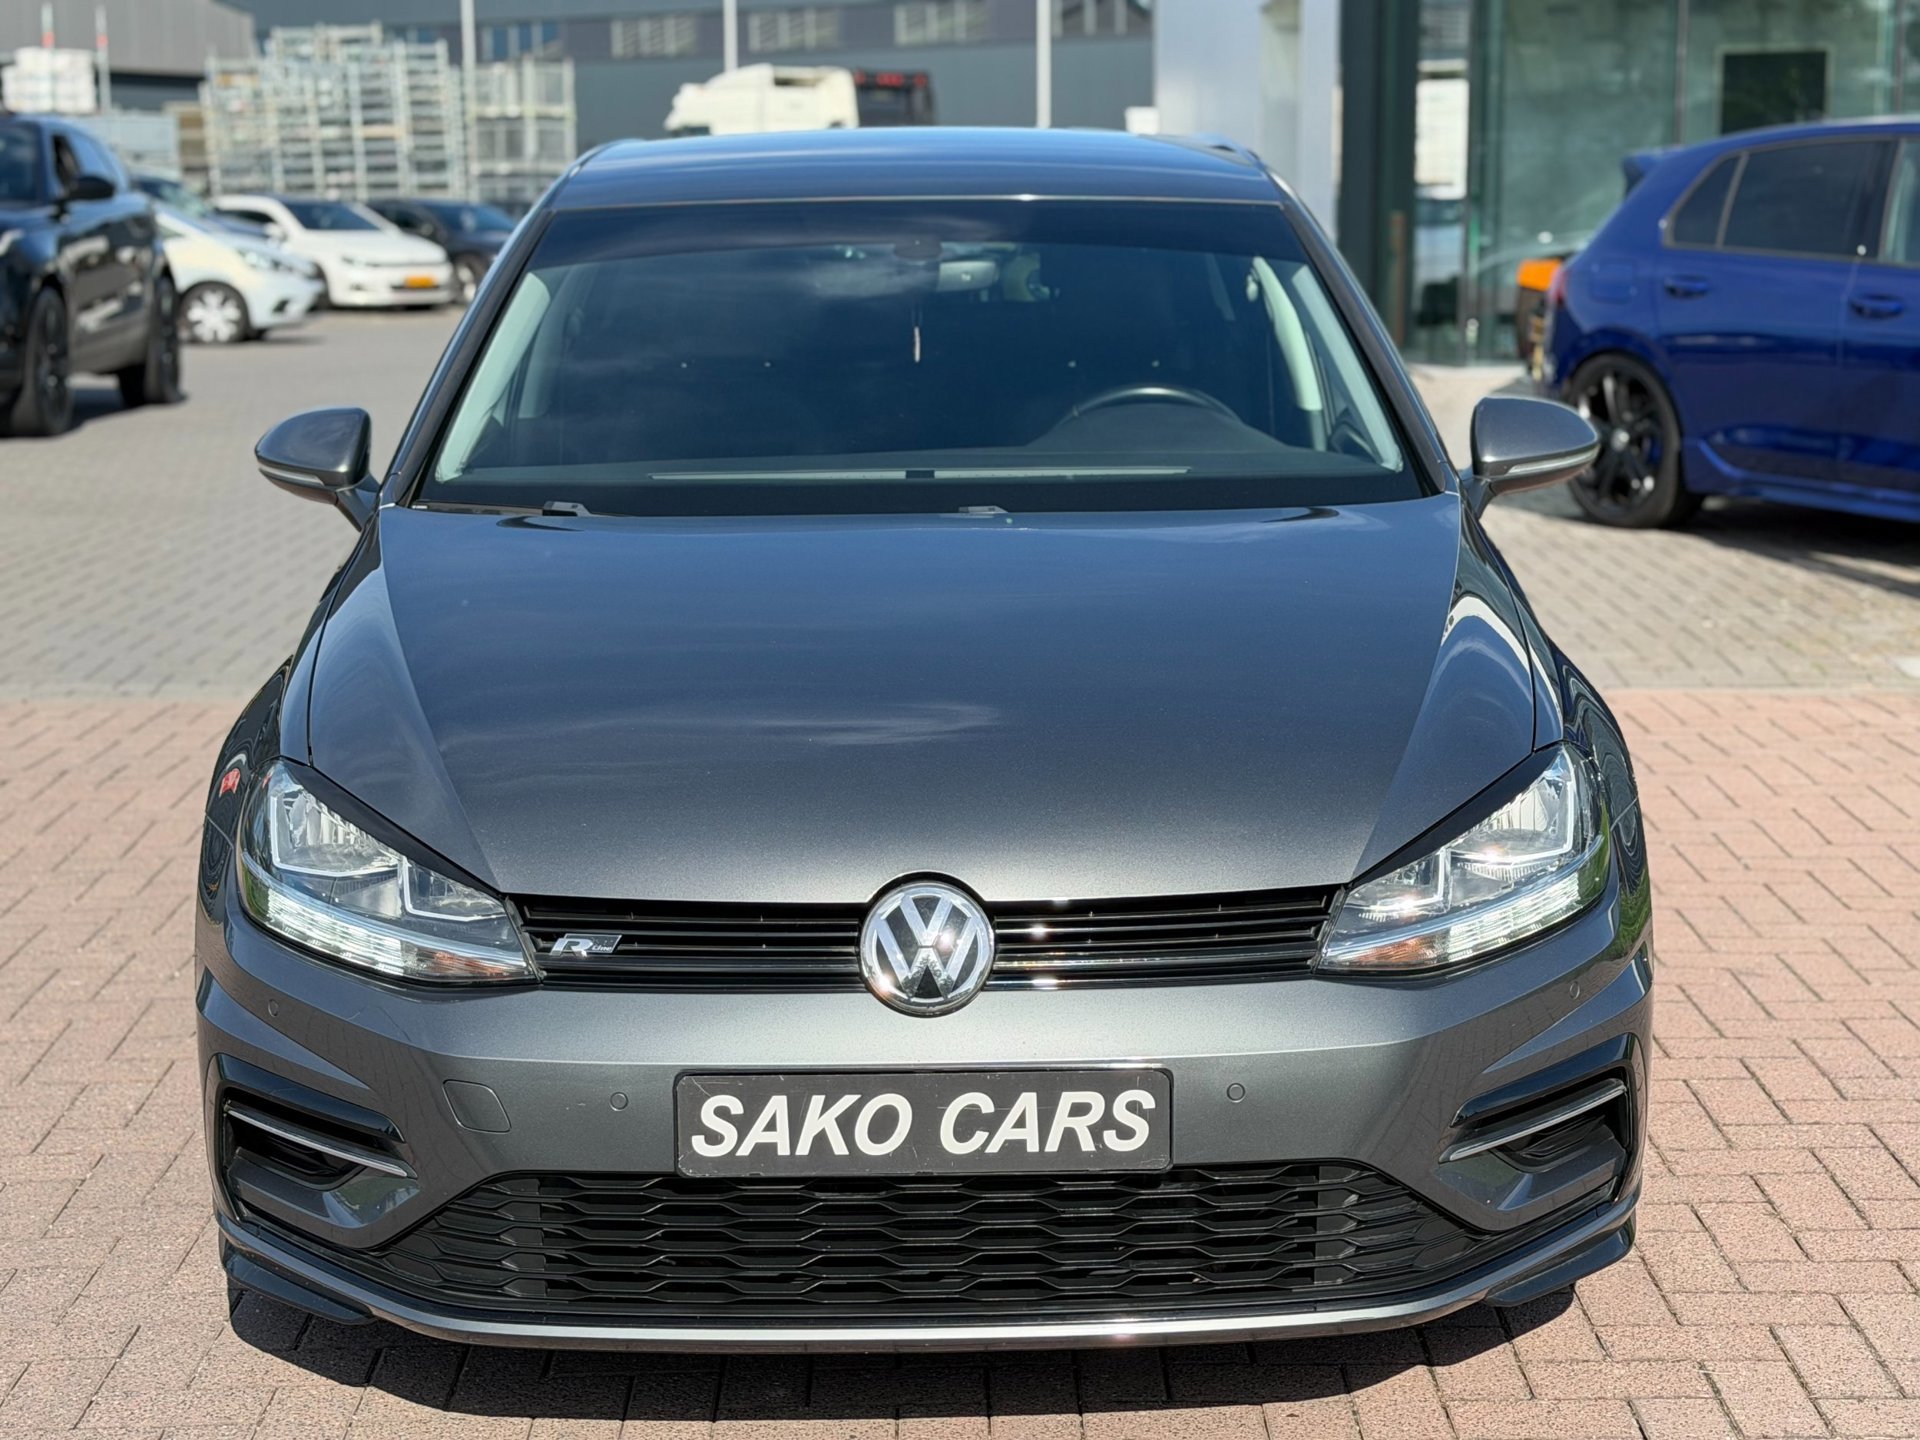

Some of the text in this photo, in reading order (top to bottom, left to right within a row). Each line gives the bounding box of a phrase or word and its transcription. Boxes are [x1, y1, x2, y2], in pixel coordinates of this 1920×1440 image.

[866, 888, 989, 1002] VW
[692, 1090, 1155, 1157] SAKO CARS
